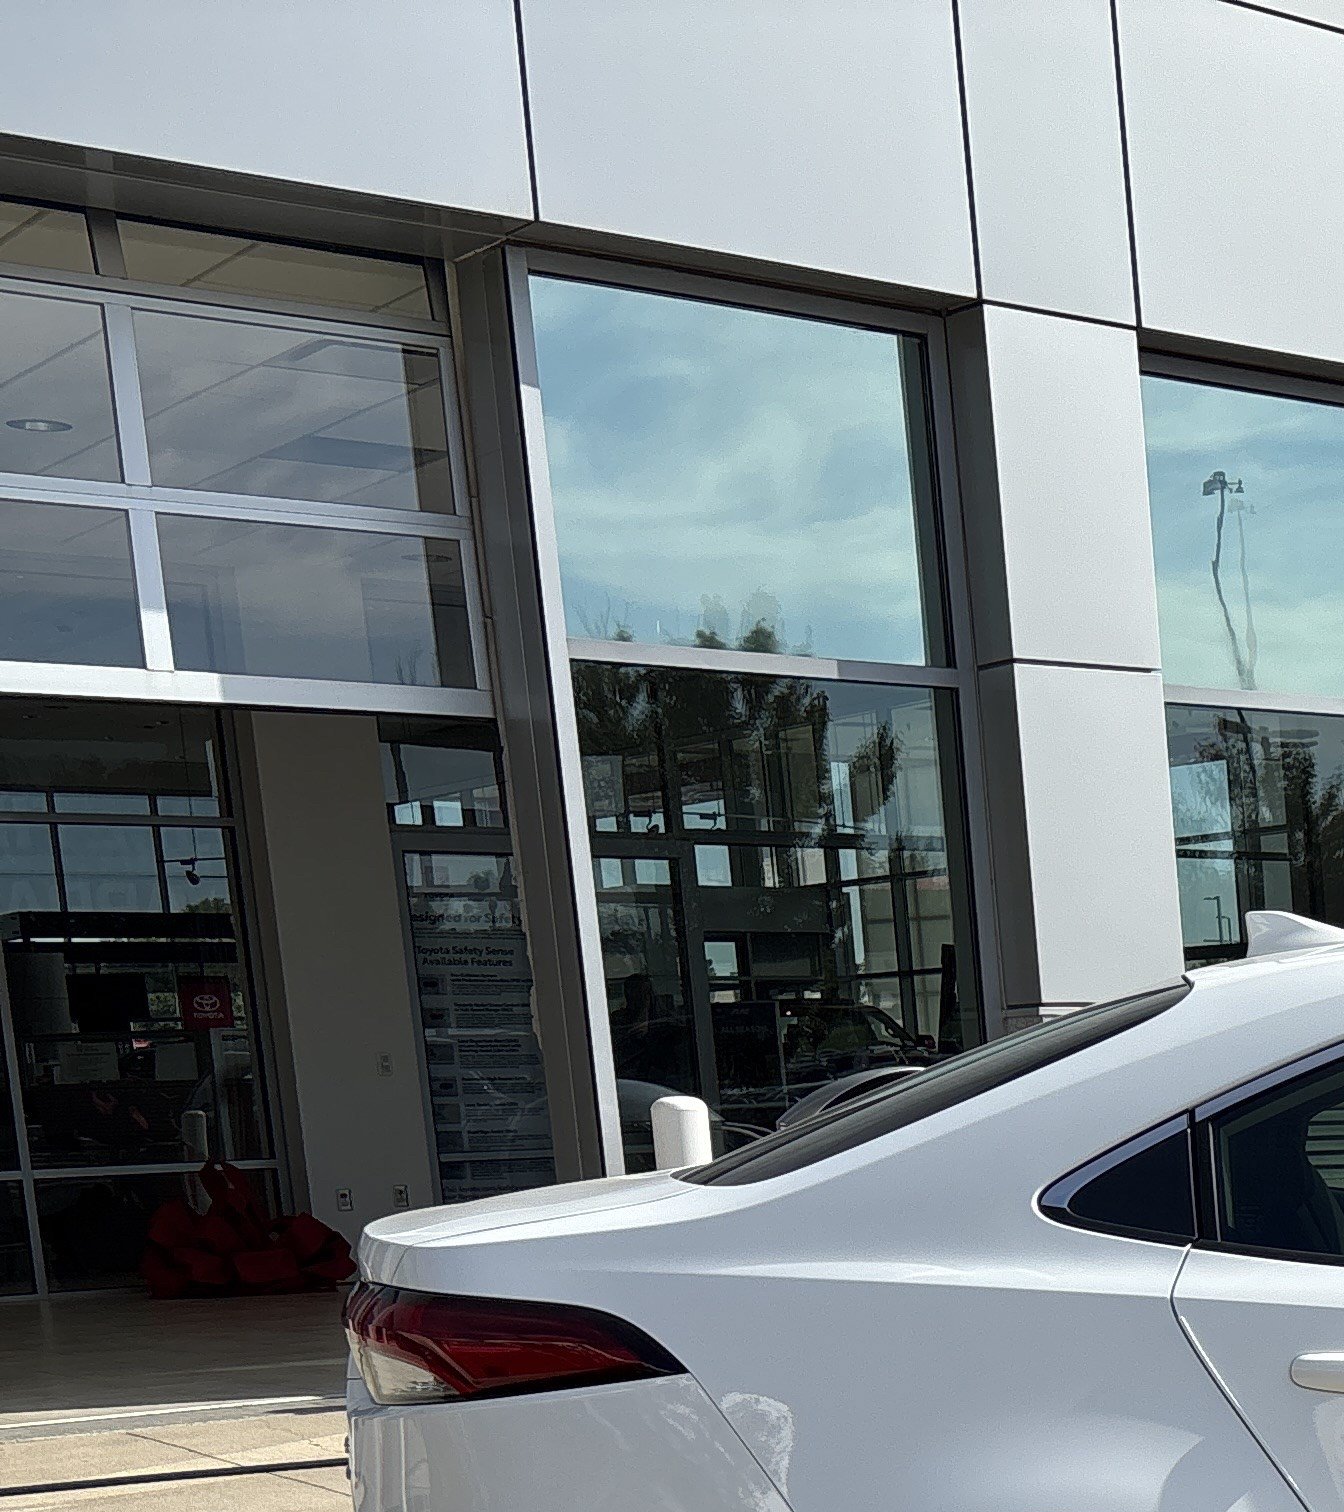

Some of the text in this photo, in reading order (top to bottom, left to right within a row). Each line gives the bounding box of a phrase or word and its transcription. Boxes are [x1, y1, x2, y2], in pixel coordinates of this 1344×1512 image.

[416, 945, 514, 957] Toyota Safety Sense
[421, 957, 513, 967] Available Features
